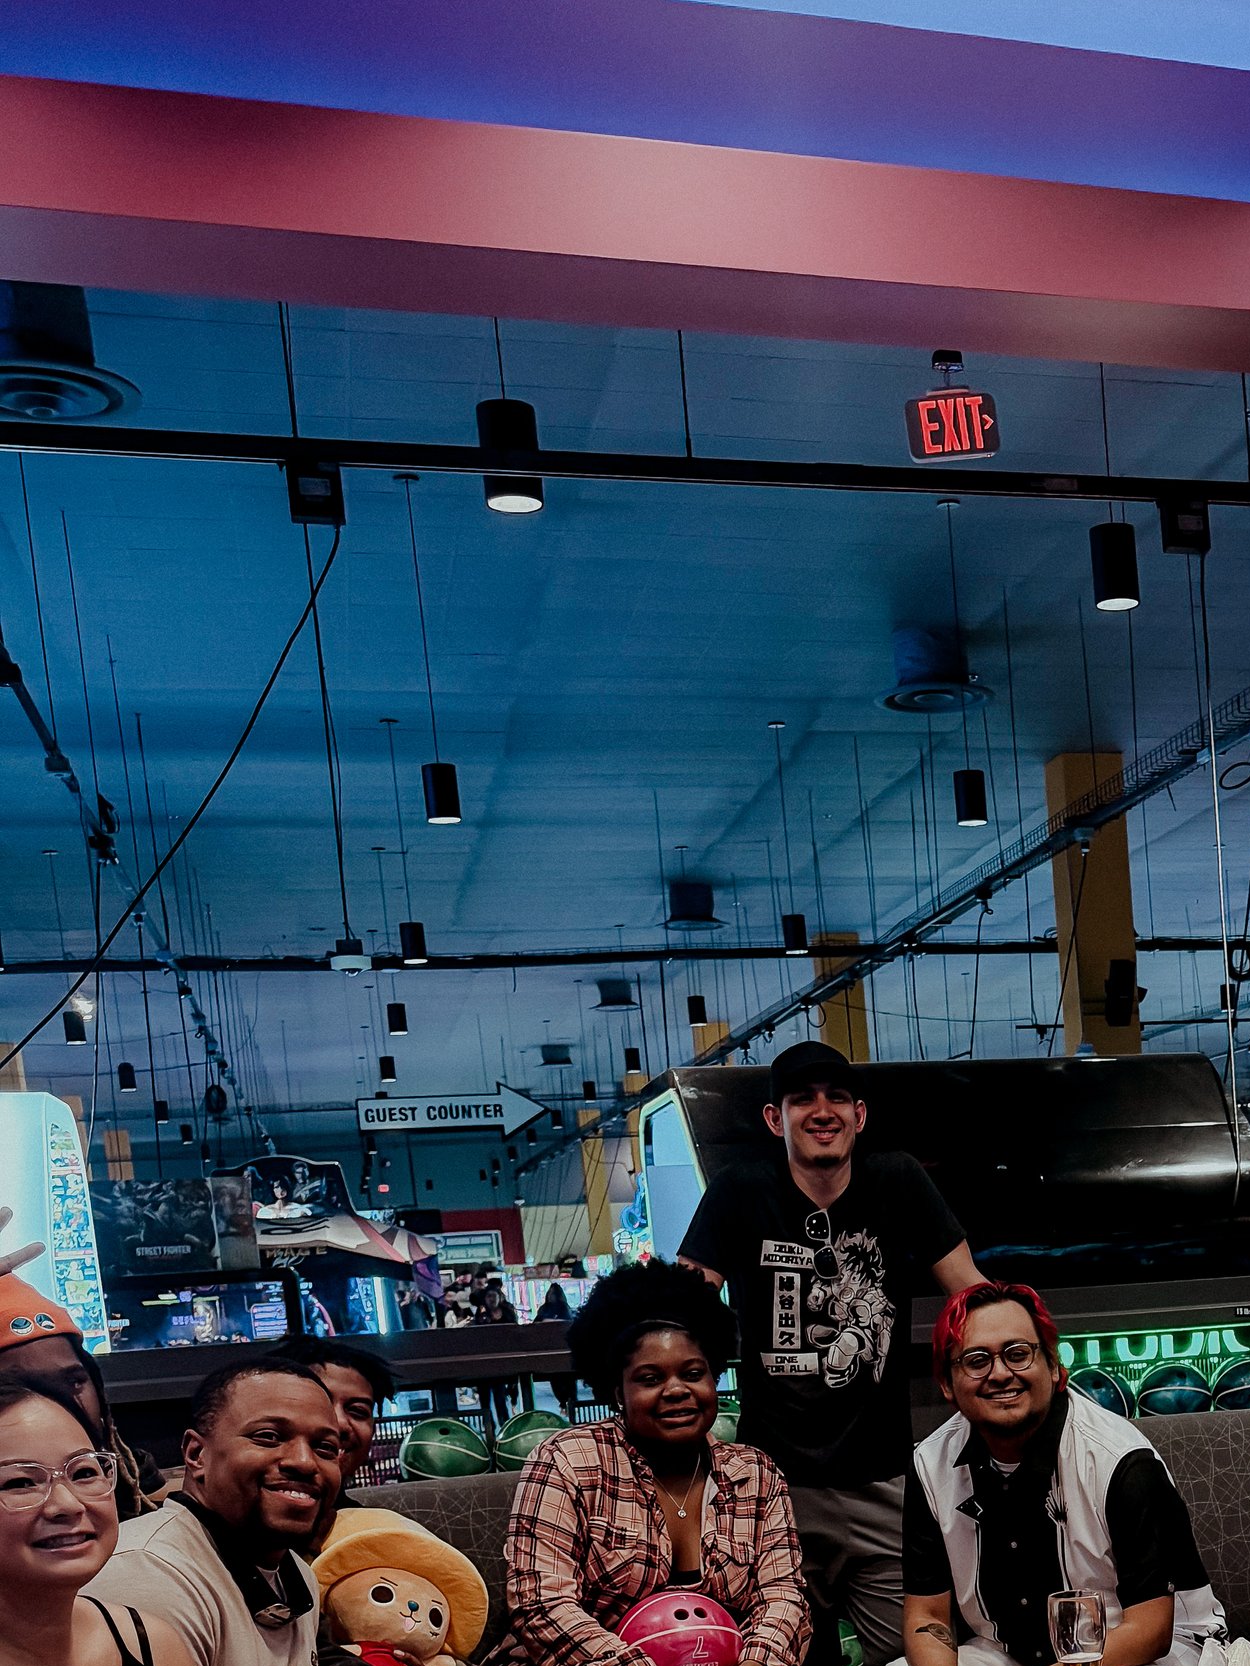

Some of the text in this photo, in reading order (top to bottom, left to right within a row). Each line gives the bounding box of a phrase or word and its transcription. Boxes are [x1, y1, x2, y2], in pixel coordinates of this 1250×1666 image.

[918, 396, 984, 454] EXIT
[364, 1103, 504, 1123] GUEST COUNTER
[763, 1253, 813, 1266] MIDORIYA
[775, 1355, 798, 1364] ONE
[790, 1364, 813, 1373] ALL
[692, 1636, 708, 1659] 7
